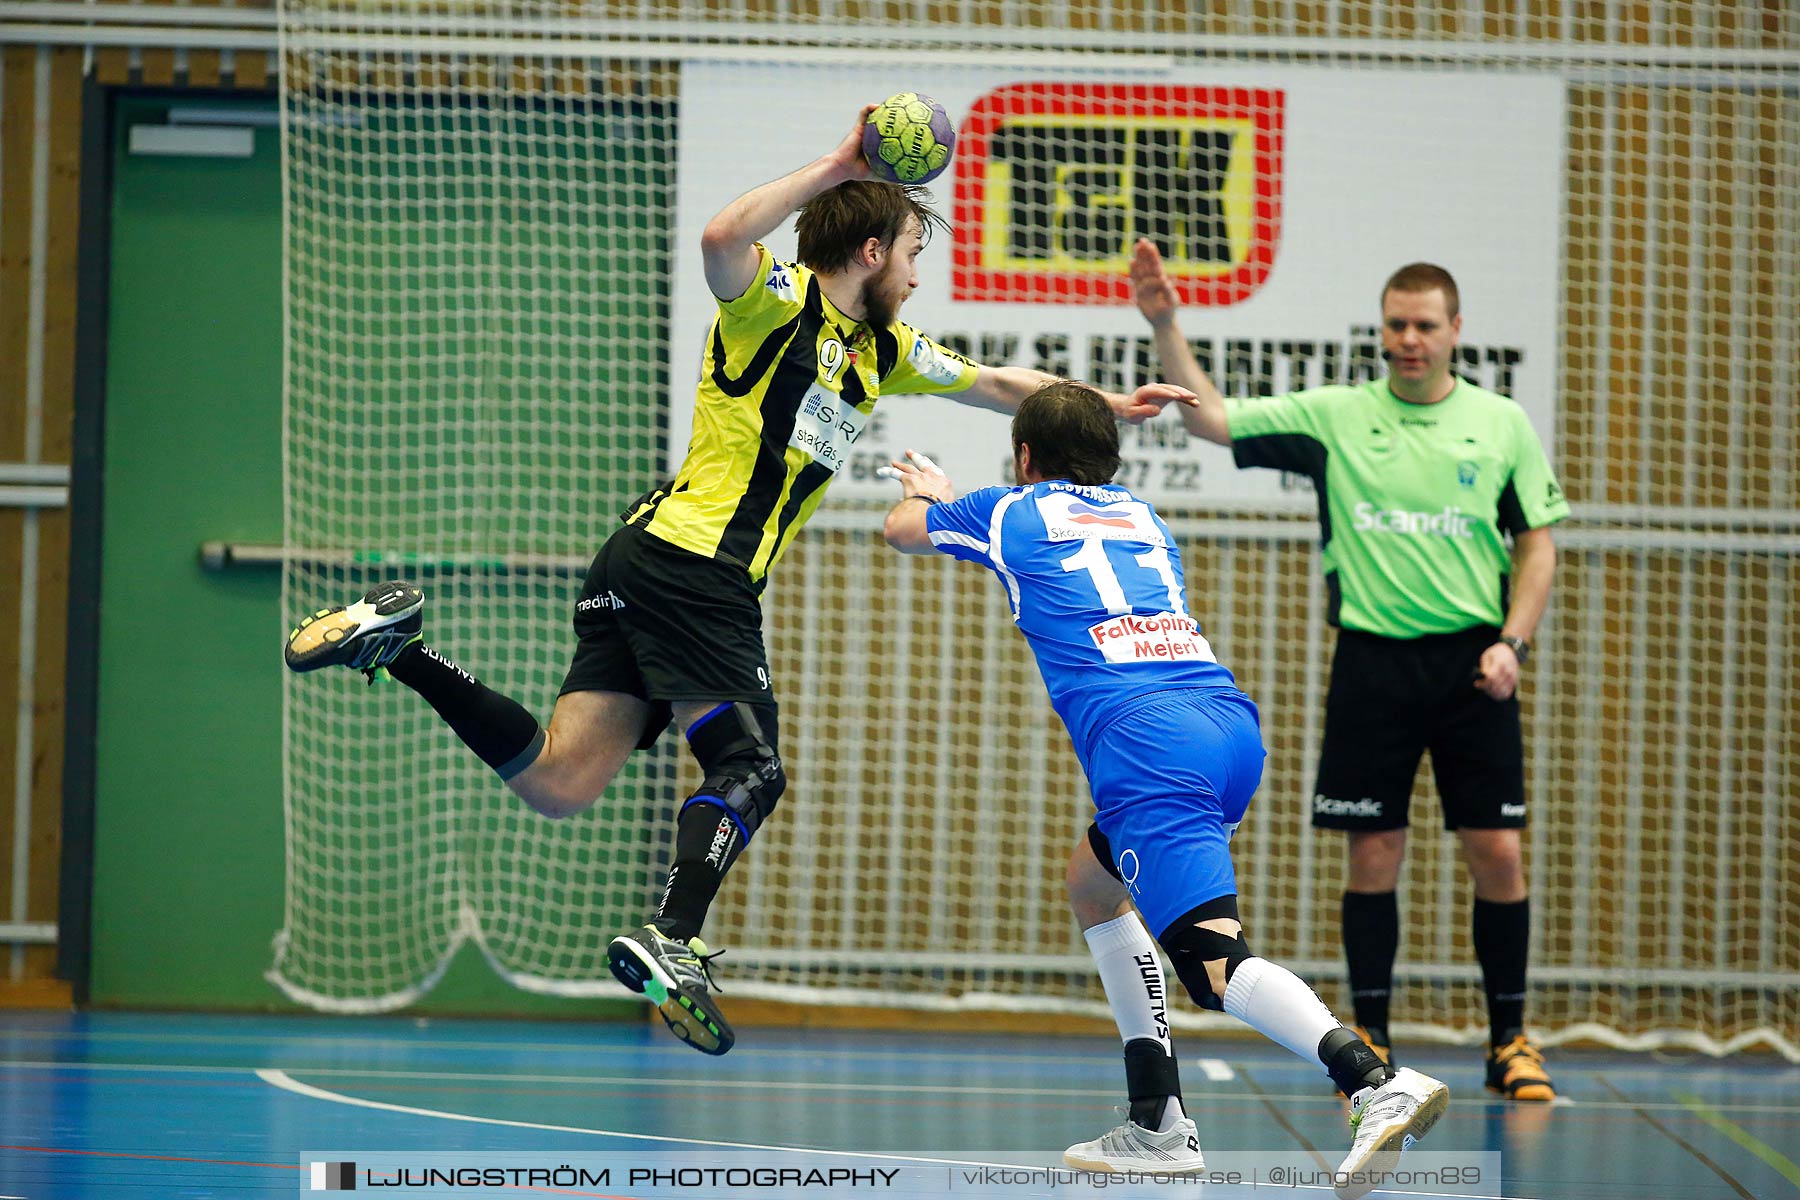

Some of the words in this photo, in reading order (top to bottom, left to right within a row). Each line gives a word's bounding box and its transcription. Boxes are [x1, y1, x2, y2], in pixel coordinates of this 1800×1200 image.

[819, 338, 845, 383] 9
[1353, 502, 1476, 538] Scandic
[1059, 539, 1189, 616] 11
[1134, 638, 1199, 661] Mejeri
[756, 666, 768, 690] 9
[1132, 951, 1171, 1041] SALMING
